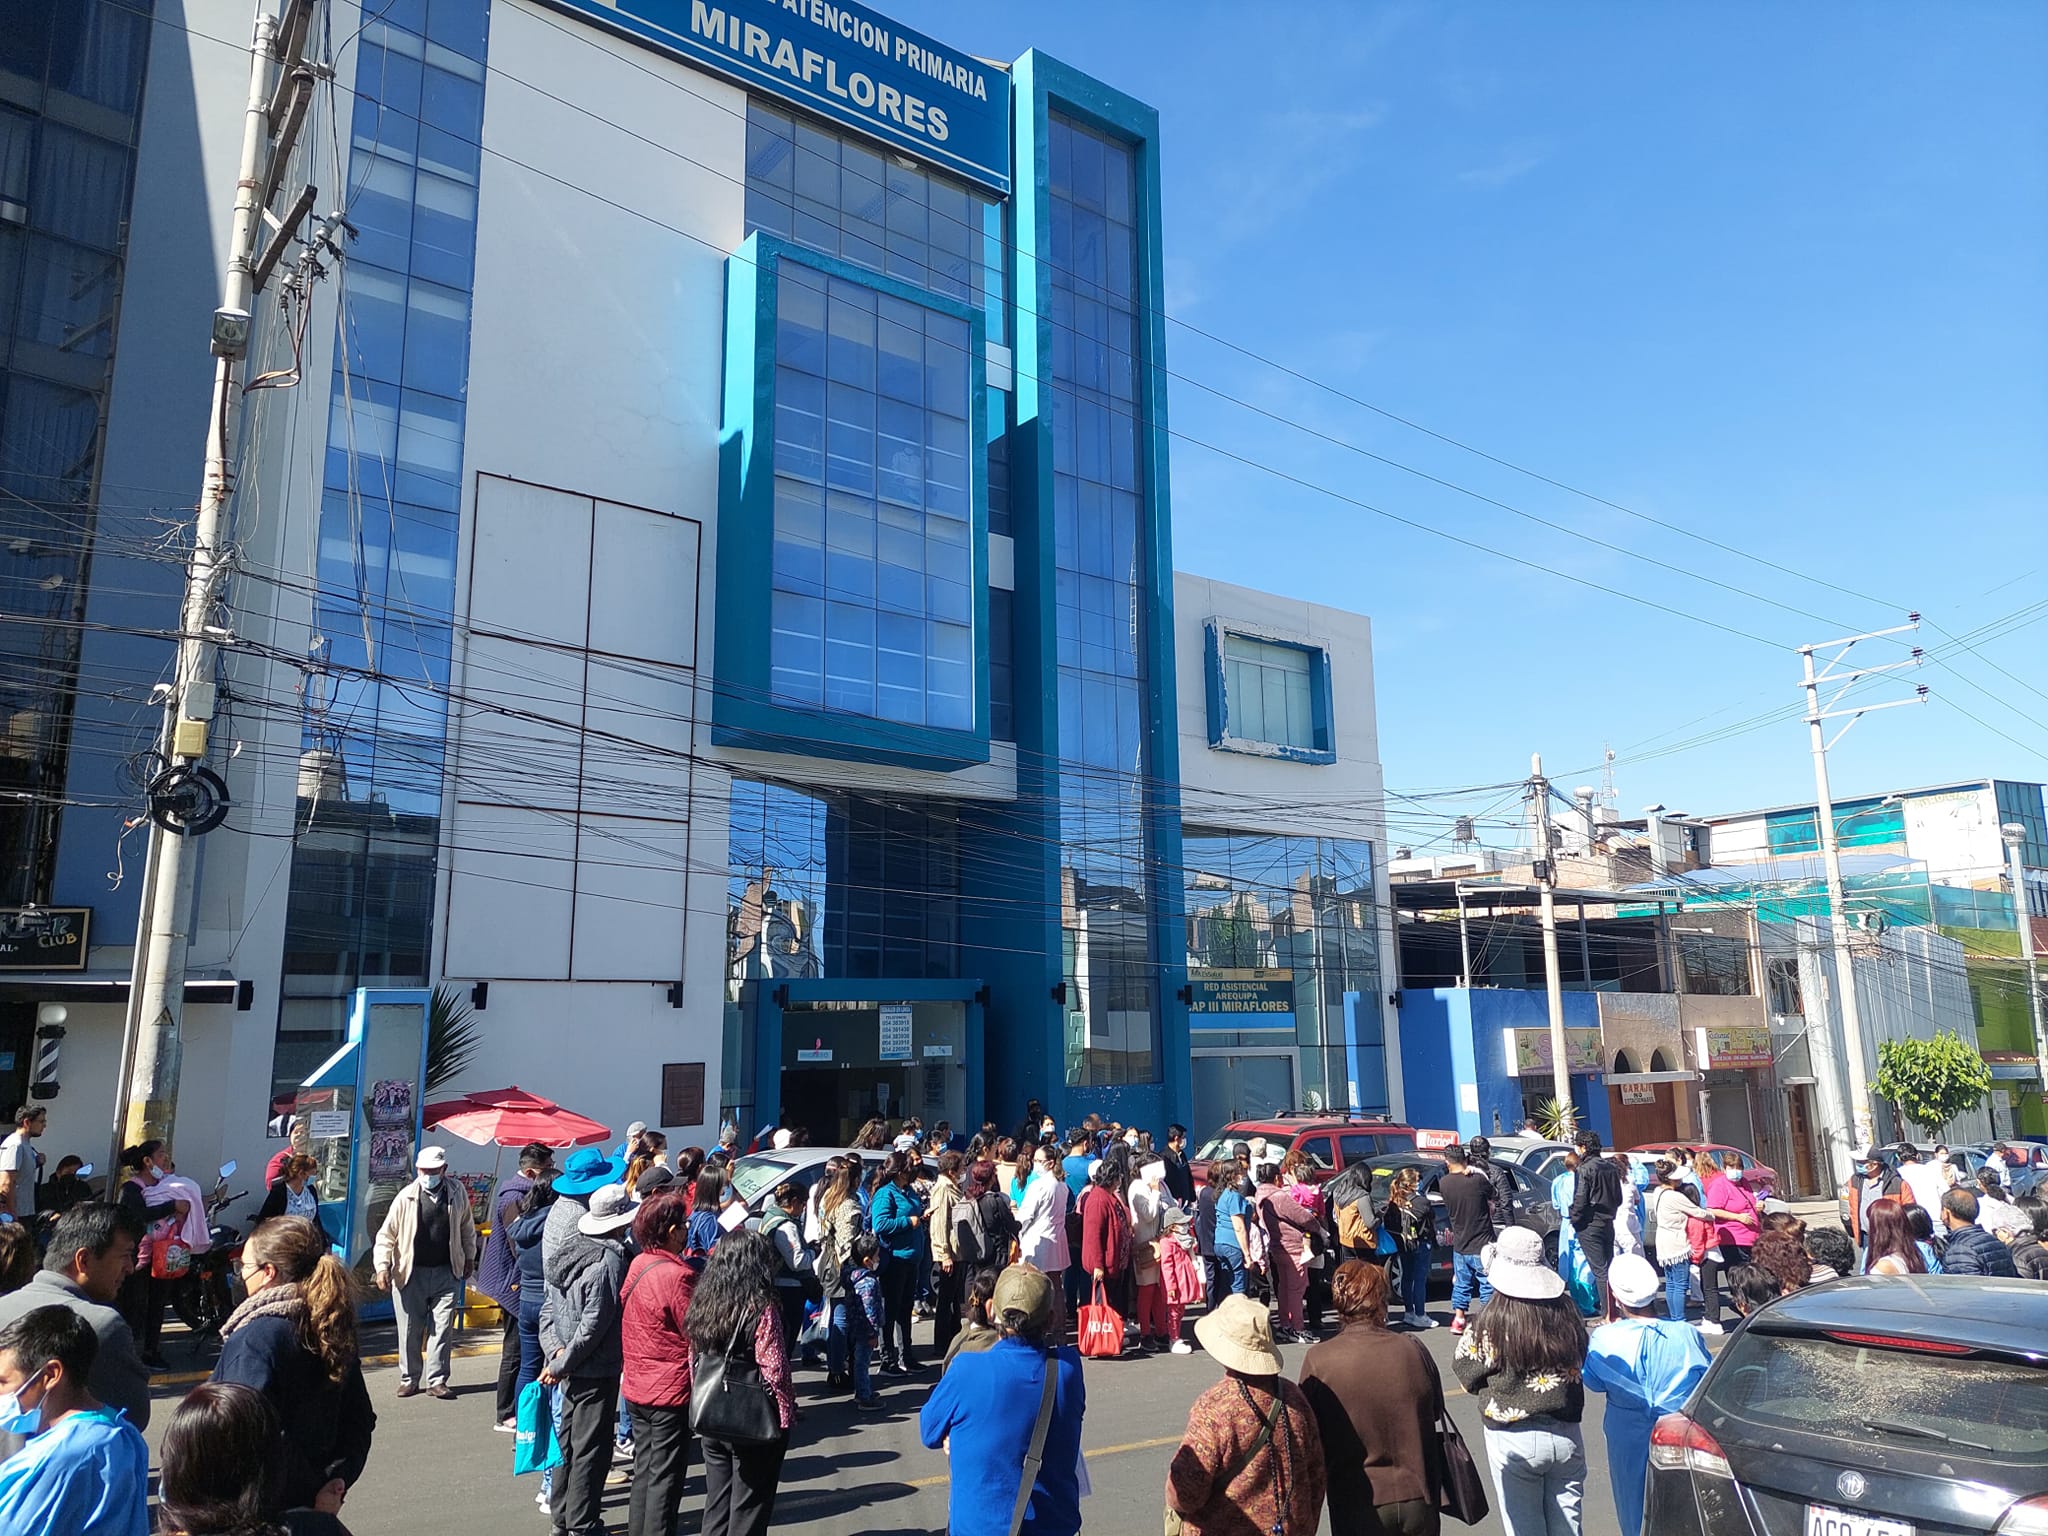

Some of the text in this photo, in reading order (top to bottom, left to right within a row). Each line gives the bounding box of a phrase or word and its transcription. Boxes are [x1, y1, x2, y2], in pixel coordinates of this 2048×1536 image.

[782, 0, 987, 101] ATENCION PRIMARIA
[691, 0, 949, 141] MIRAFLORES
[38, 932, 78, 948] CLUB
[1204, 983, 1268, 991] RED ASISTENCIAL
[1216, 992, 1258, 1000] AREQUIPA
[1189, 1001, 1289, 1011] AP III MIRAFLORES
[1623, 1083, 1653, 1092] GARAJE
